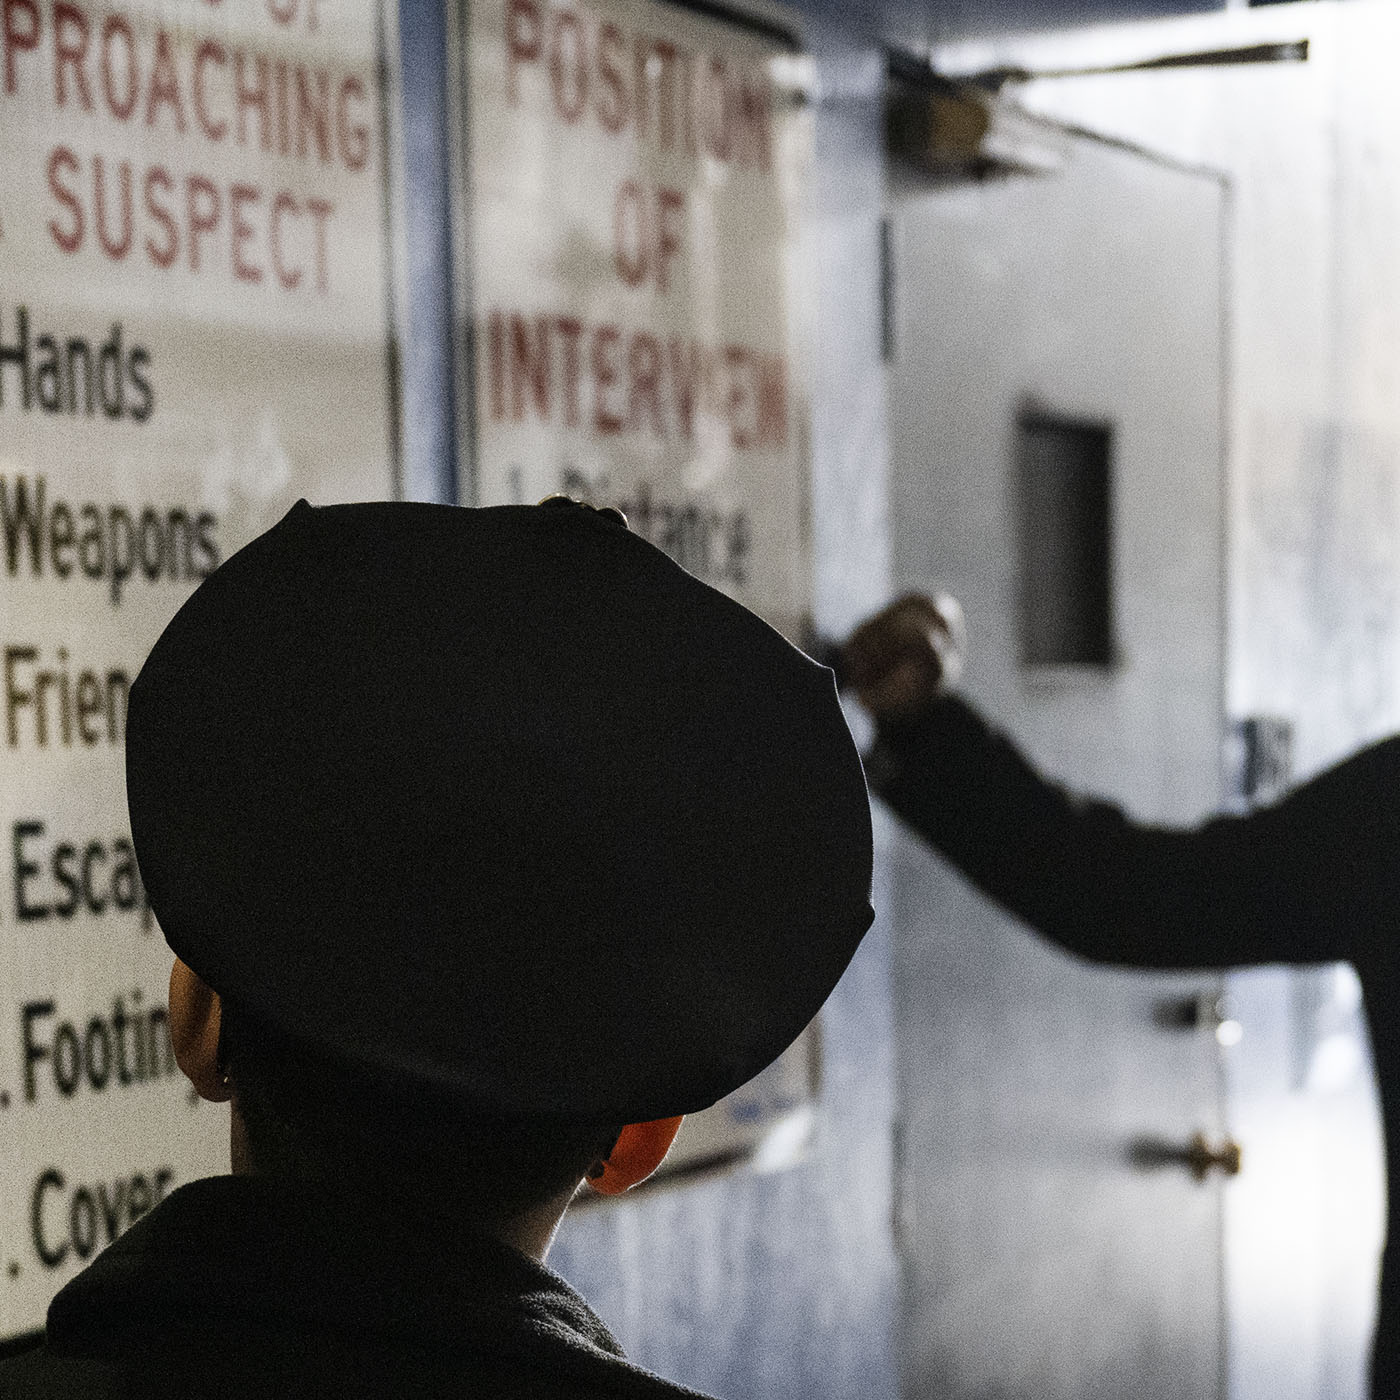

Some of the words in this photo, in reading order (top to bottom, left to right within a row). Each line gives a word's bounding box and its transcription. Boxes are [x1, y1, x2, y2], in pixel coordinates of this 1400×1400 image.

[504, 0, 772, 174] POSITION
[45, 144, 335, 294] SUSPECT
[613, 178, 685, 292] OF
[3, 646, 131, 748] Frien
[20, 988, 197, 1105] Footin
